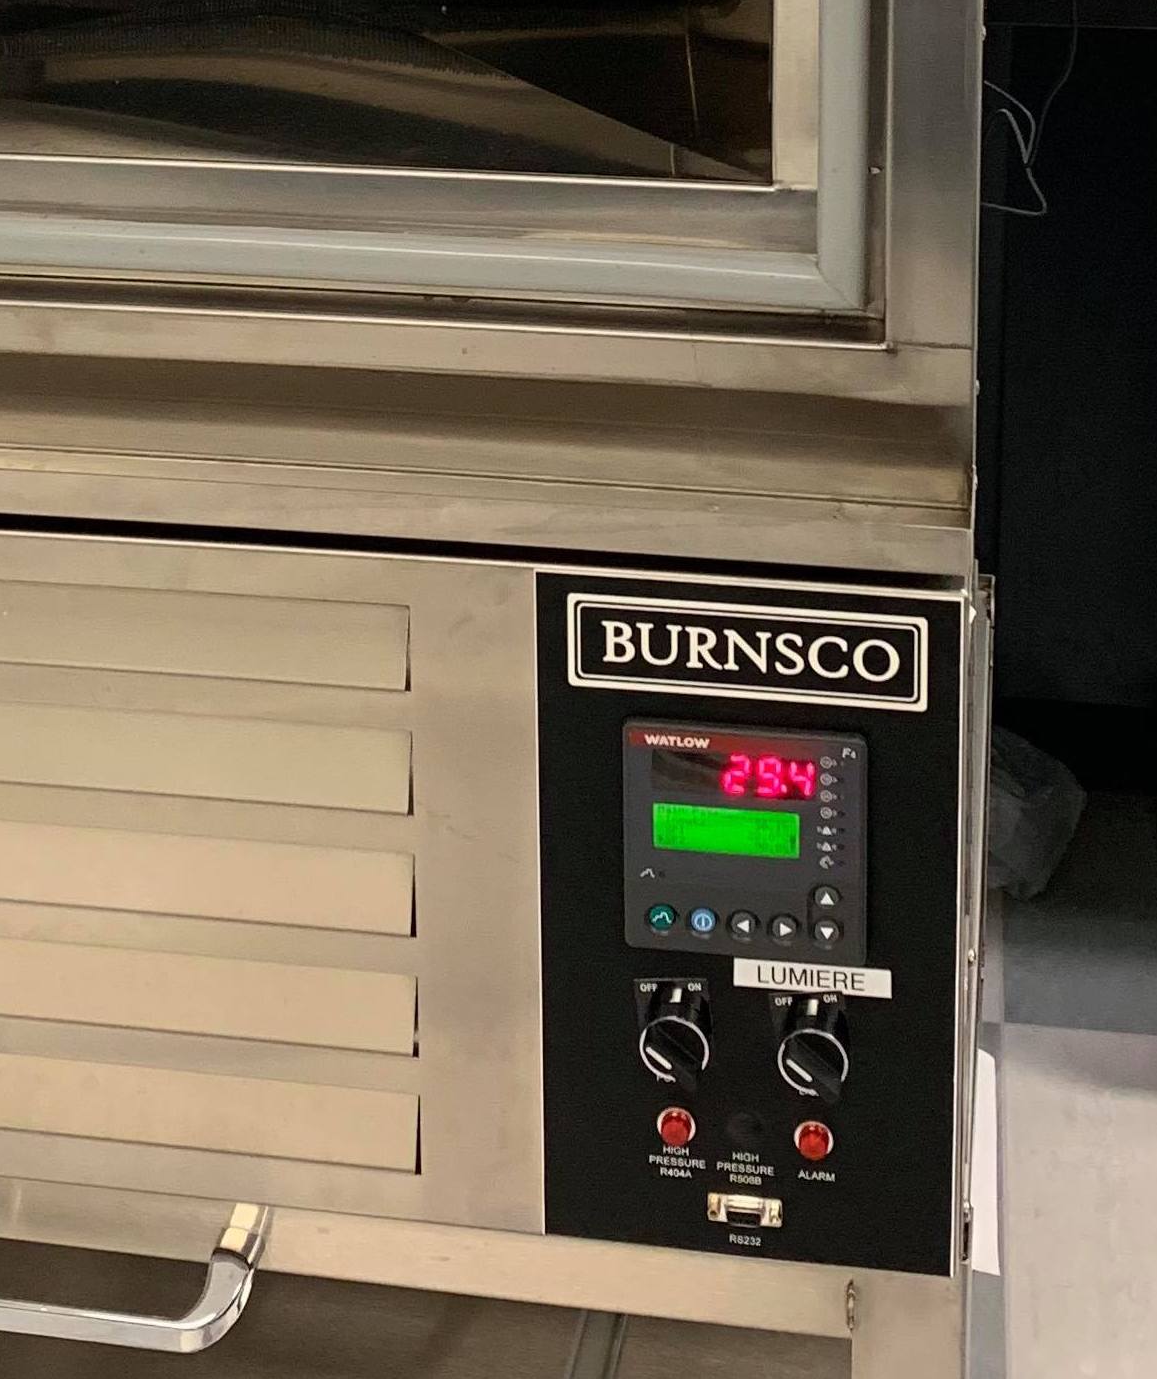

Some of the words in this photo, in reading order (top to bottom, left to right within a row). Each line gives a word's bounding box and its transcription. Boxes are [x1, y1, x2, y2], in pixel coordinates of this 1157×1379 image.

[601, 620, 901, 682] BURNSCO
[644, 733, 710, 749] WATLOW
[720, 753, 817, 798] 29.4
[757, 965, 866, 991] LUMIERE
[639, 983, 658, 992] OFF
[687, 982, 702, 992] ON
[774, 996, 793, 1007] OFF
[823, 994, 838, 1004] ON
[662, 1146, 690, 1156] HIGH
[648, 1155, 706, 1169] PRESSURE
[732, 1152, 760, 1163] HIGH
[660, 1167, 693, 1179] R404A
[716, 1162, 775, 1176] PRESSURE
[798, 1170, 836, 1182] ALARM
[729, 1234, 762, 1247] RS232
